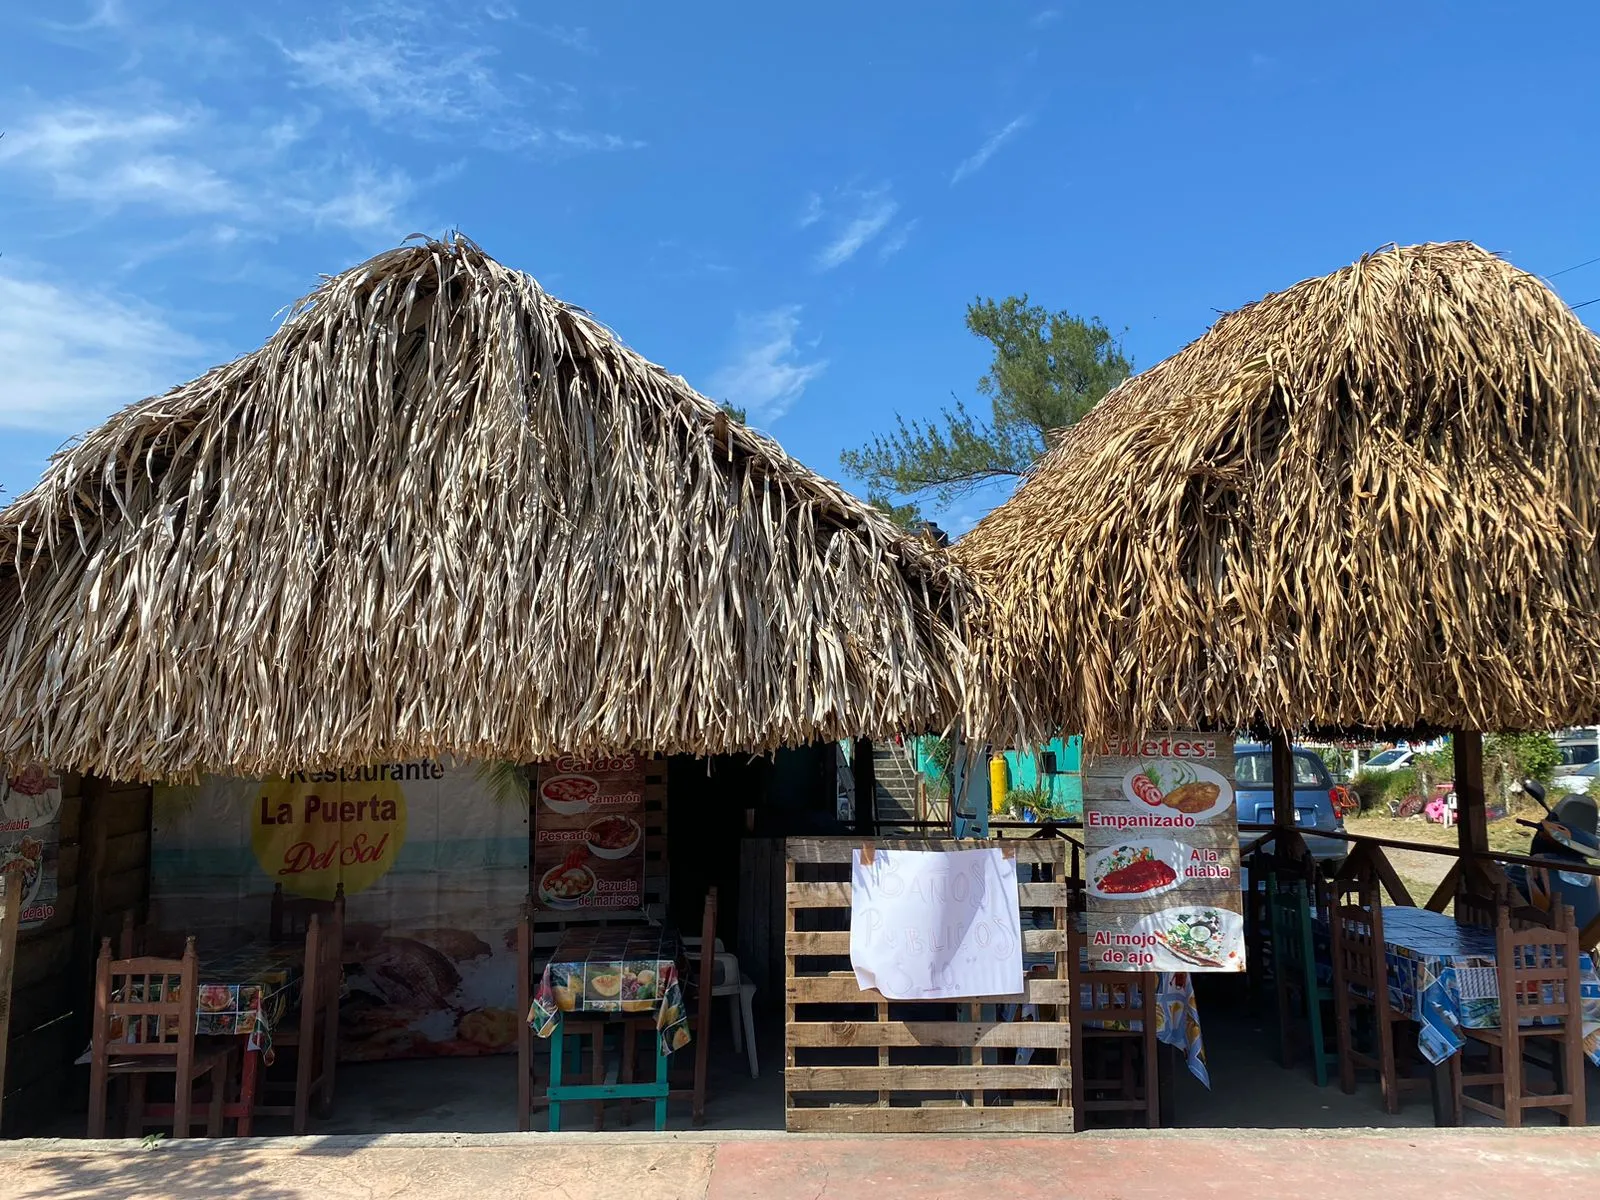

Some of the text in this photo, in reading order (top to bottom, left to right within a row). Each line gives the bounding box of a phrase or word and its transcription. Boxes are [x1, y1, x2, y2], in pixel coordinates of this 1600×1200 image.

[290, 758, 445, 784] Restaurante
[586, 791, 641, 805] Camarón
[261, 794, 397, 825] La Puerta
[1088, 811, 1195, 830] Empanizado
[540, 830, 593, 841] Pescado
[278, 833, 389, 876] Del Sol
[1190, 849, 1218, 862] A la
[1184, 864, 1231, 878] diabla
[597, 879, 638, 892] Cazuela
[578, 893, 640, 907] de mariscos
[1094, 931, 1157, 948] Al mojo
[1102, 949, 1154, 966] de ajo
